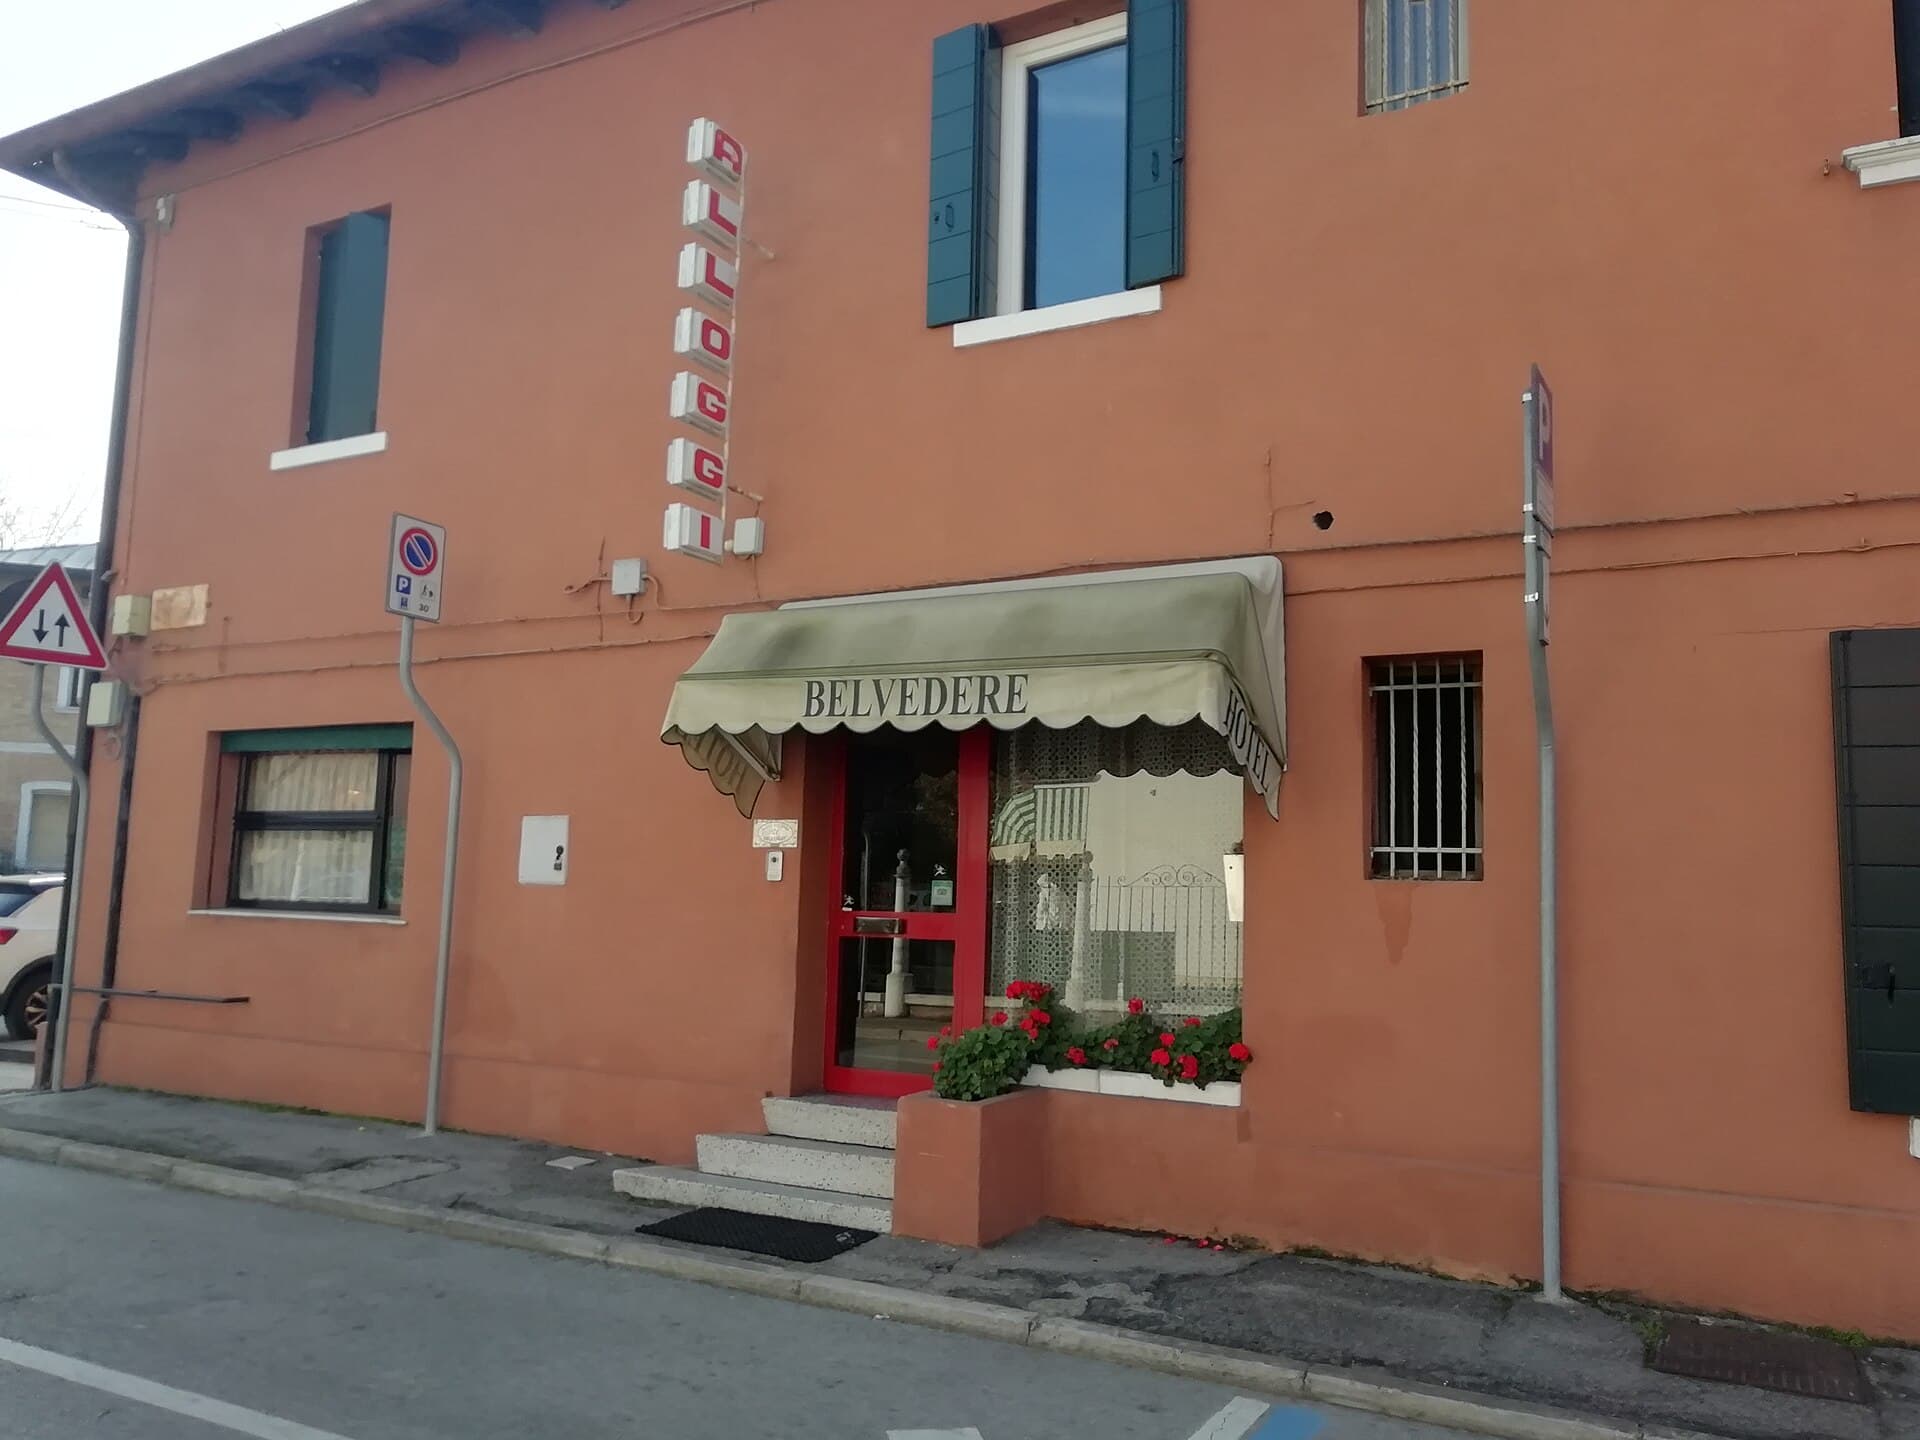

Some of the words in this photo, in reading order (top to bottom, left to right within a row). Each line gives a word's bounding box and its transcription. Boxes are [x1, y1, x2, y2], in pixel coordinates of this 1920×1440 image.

[694, 128, 743, 549] ALLOGGI
[803, 673, 1029, 717] BELVEDERE
[1223, 689, 1269, 793] HOTEL
